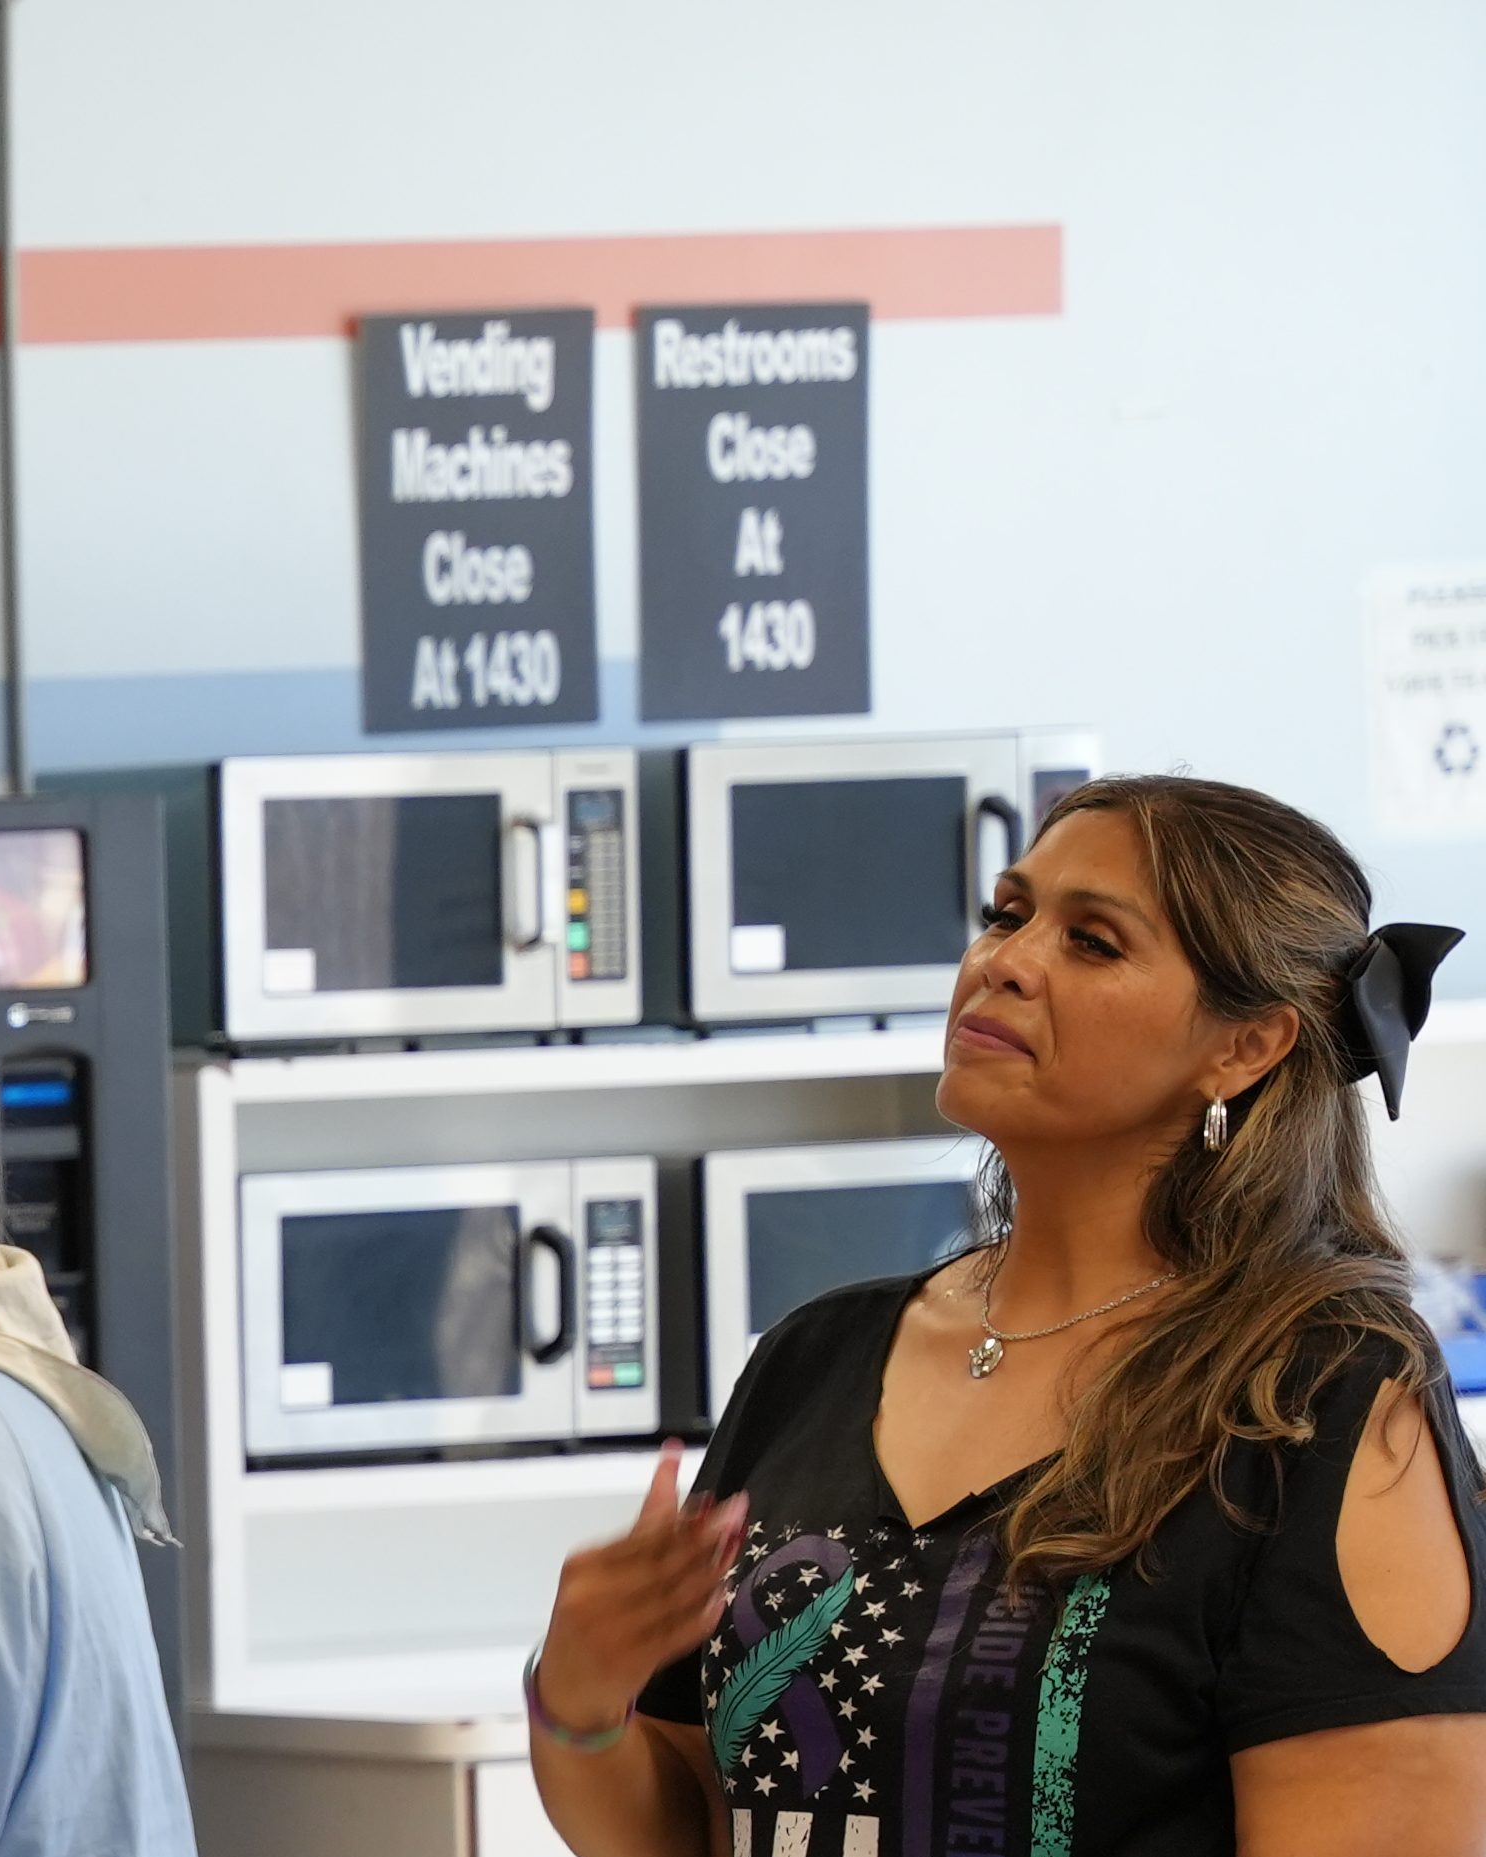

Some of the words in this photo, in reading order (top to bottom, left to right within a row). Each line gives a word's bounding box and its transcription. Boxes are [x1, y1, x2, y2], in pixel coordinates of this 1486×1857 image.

[399, 321, 554, 412] Vending
[653, 318, 859, 390] Restrooms
[391, 425, 573, 502] Machines
[706, 411, 817, 483] Close
[422, 530, 534, 607] Close
[735, 506, 783, 577] At
[411, 634, 462, 711] At
[464, 628, 561, 707] 1430
[719, 599, 817, 672] 1430
